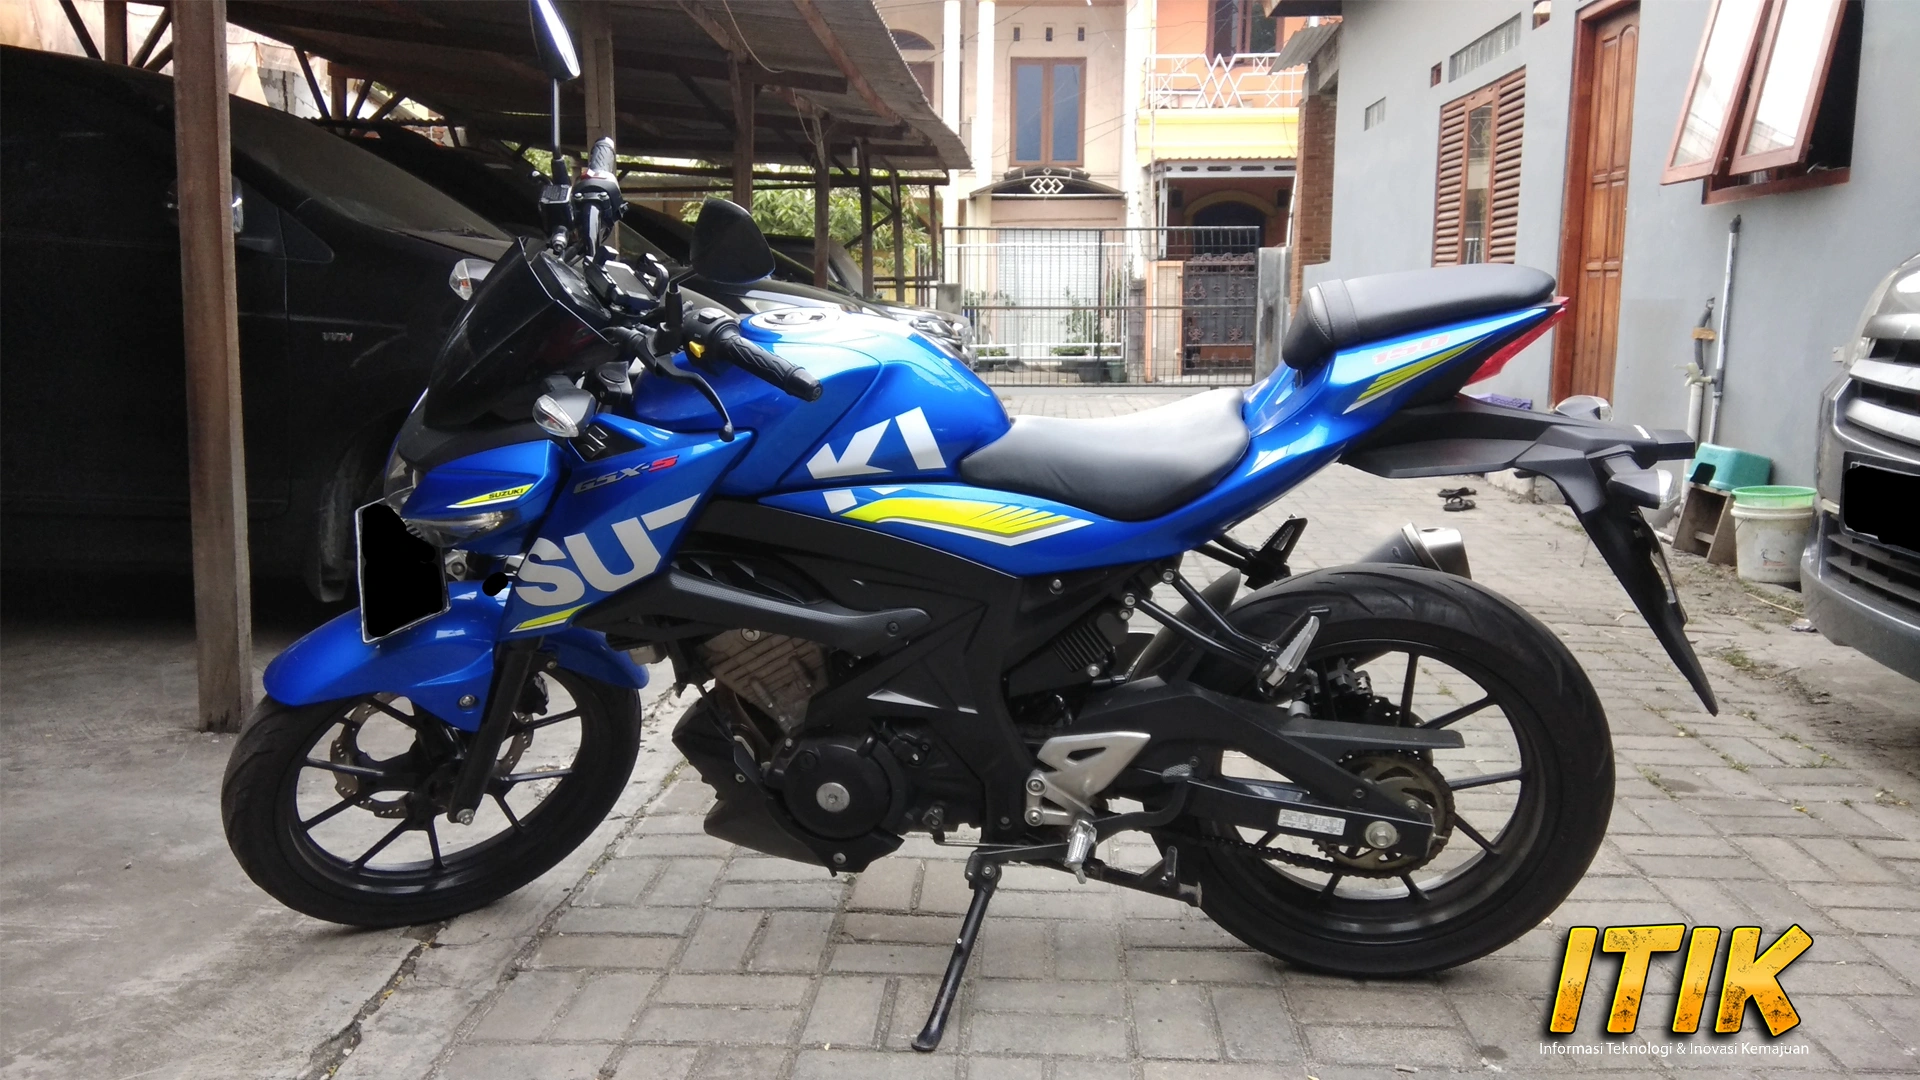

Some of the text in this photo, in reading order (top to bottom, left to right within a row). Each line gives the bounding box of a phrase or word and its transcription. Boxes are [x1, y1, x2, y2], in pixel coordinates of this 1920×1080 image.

[1373, 334, 1450, 364] 150
[573, 455, 680, 494] GSX-S
[488, 488, 524, 499] SUZUKI
